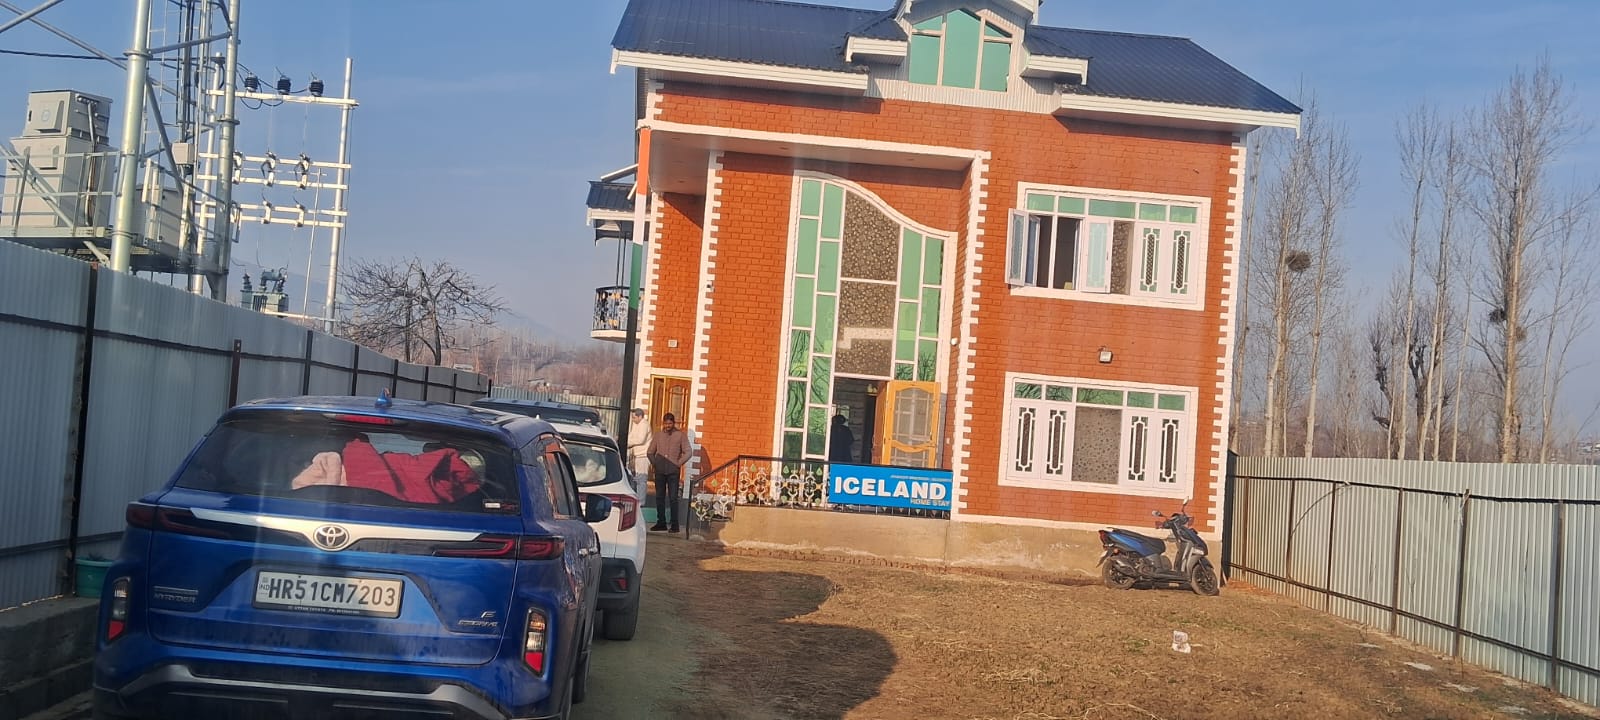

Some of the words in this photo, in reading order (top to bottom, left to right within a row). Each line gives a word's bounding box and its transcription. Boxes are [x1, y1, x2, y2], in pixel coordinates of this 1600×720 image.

[834, 476, 946, 500] ICELAND
[911, 498, 931, 506] HOME
[932, 499, 950, 507] STAY
[268, 578, 396, 607] HR51CM7203
